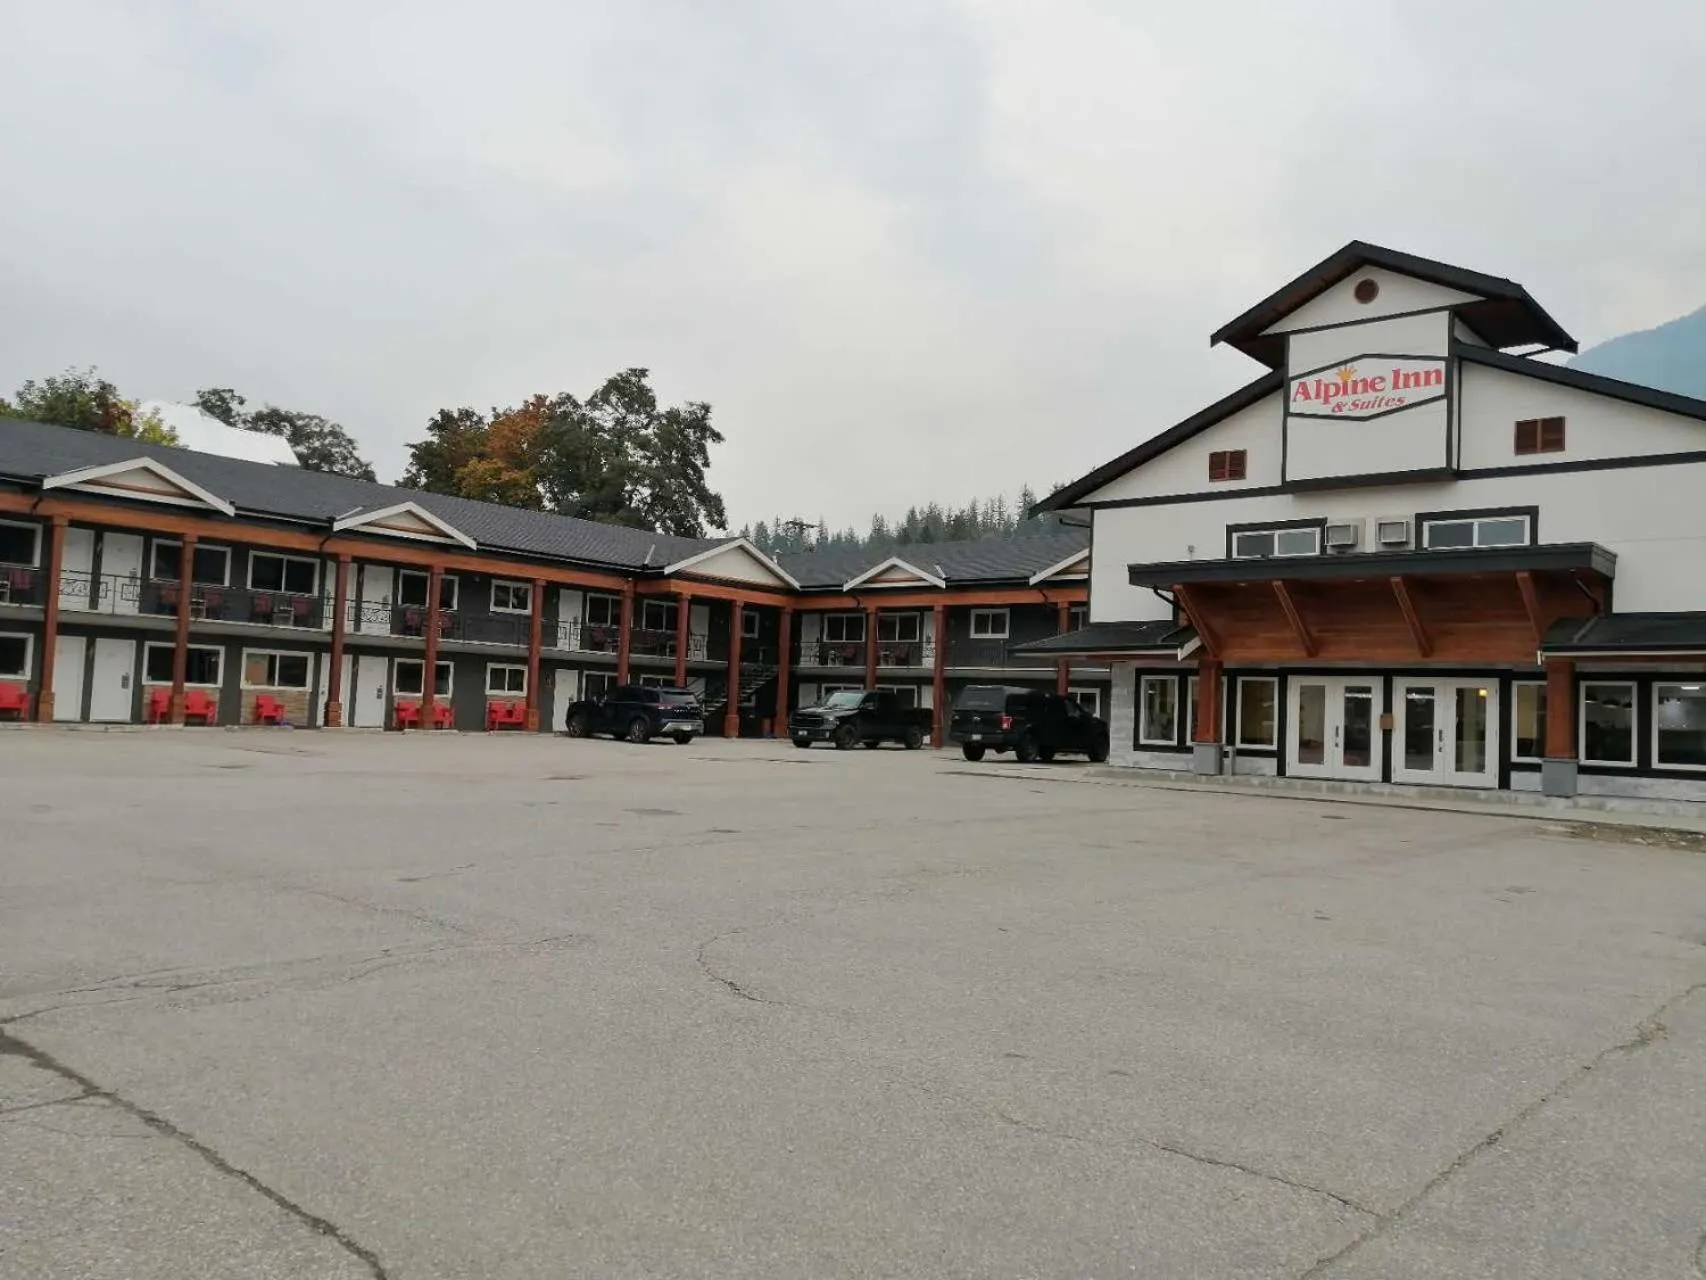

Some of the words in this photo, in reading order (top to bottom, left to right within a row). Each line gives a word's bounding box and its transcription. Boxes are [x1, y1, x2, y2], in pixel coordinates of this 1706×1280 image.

[1292, 374, 1386, 405] Alpine
[1391, 367, 1443, 391] Inn
[1331, 401, 1346, 413] &
[1348, 395, 1408, 411] Suites
